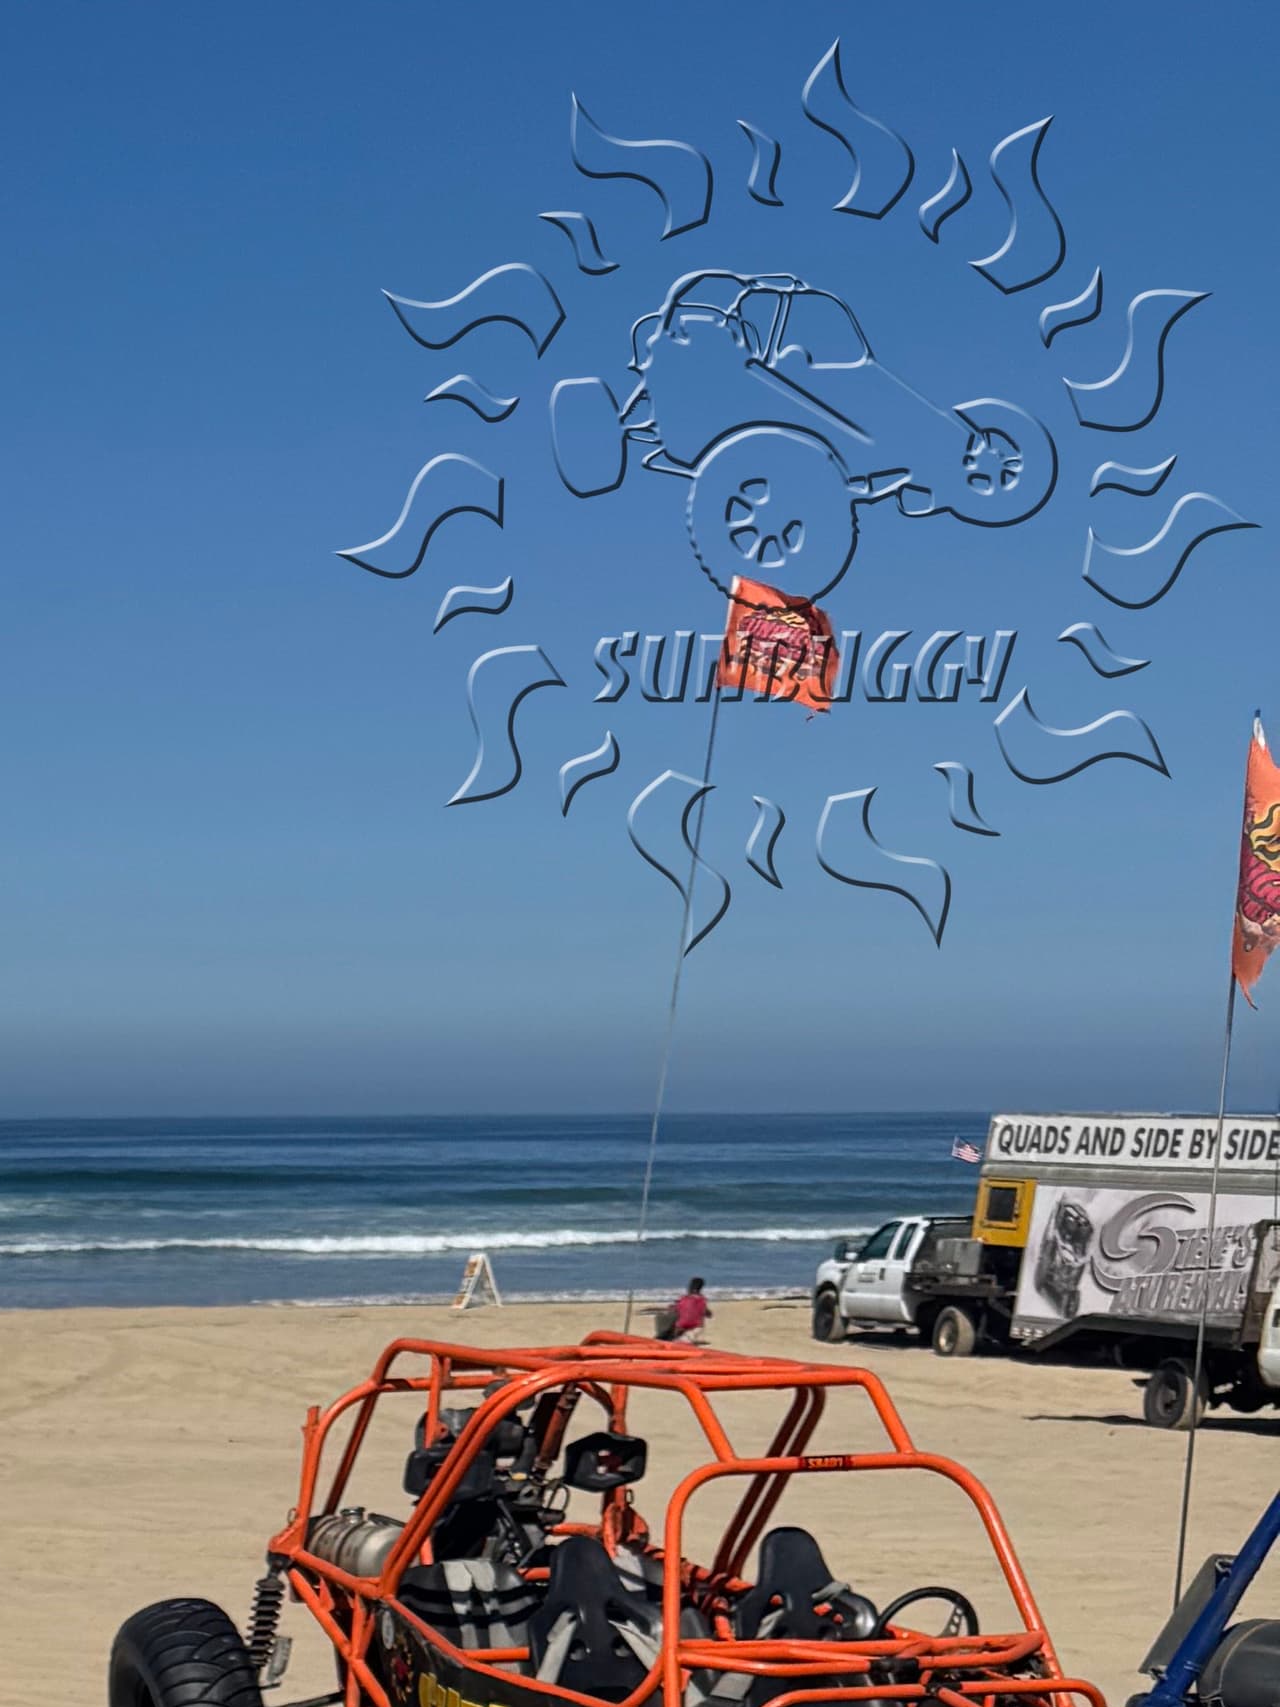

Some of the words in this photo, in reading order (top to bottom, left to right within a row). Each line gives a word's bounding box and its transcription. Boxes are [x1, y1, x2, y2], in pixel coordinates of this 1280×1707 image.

[998, 1124, 1071, 1156] QUADS
[1075, 1126, 1126, 1156] AND
[1130, 1127, 1184, 1158] SIDE
[1188, 1128, 1218, 1160] BY
